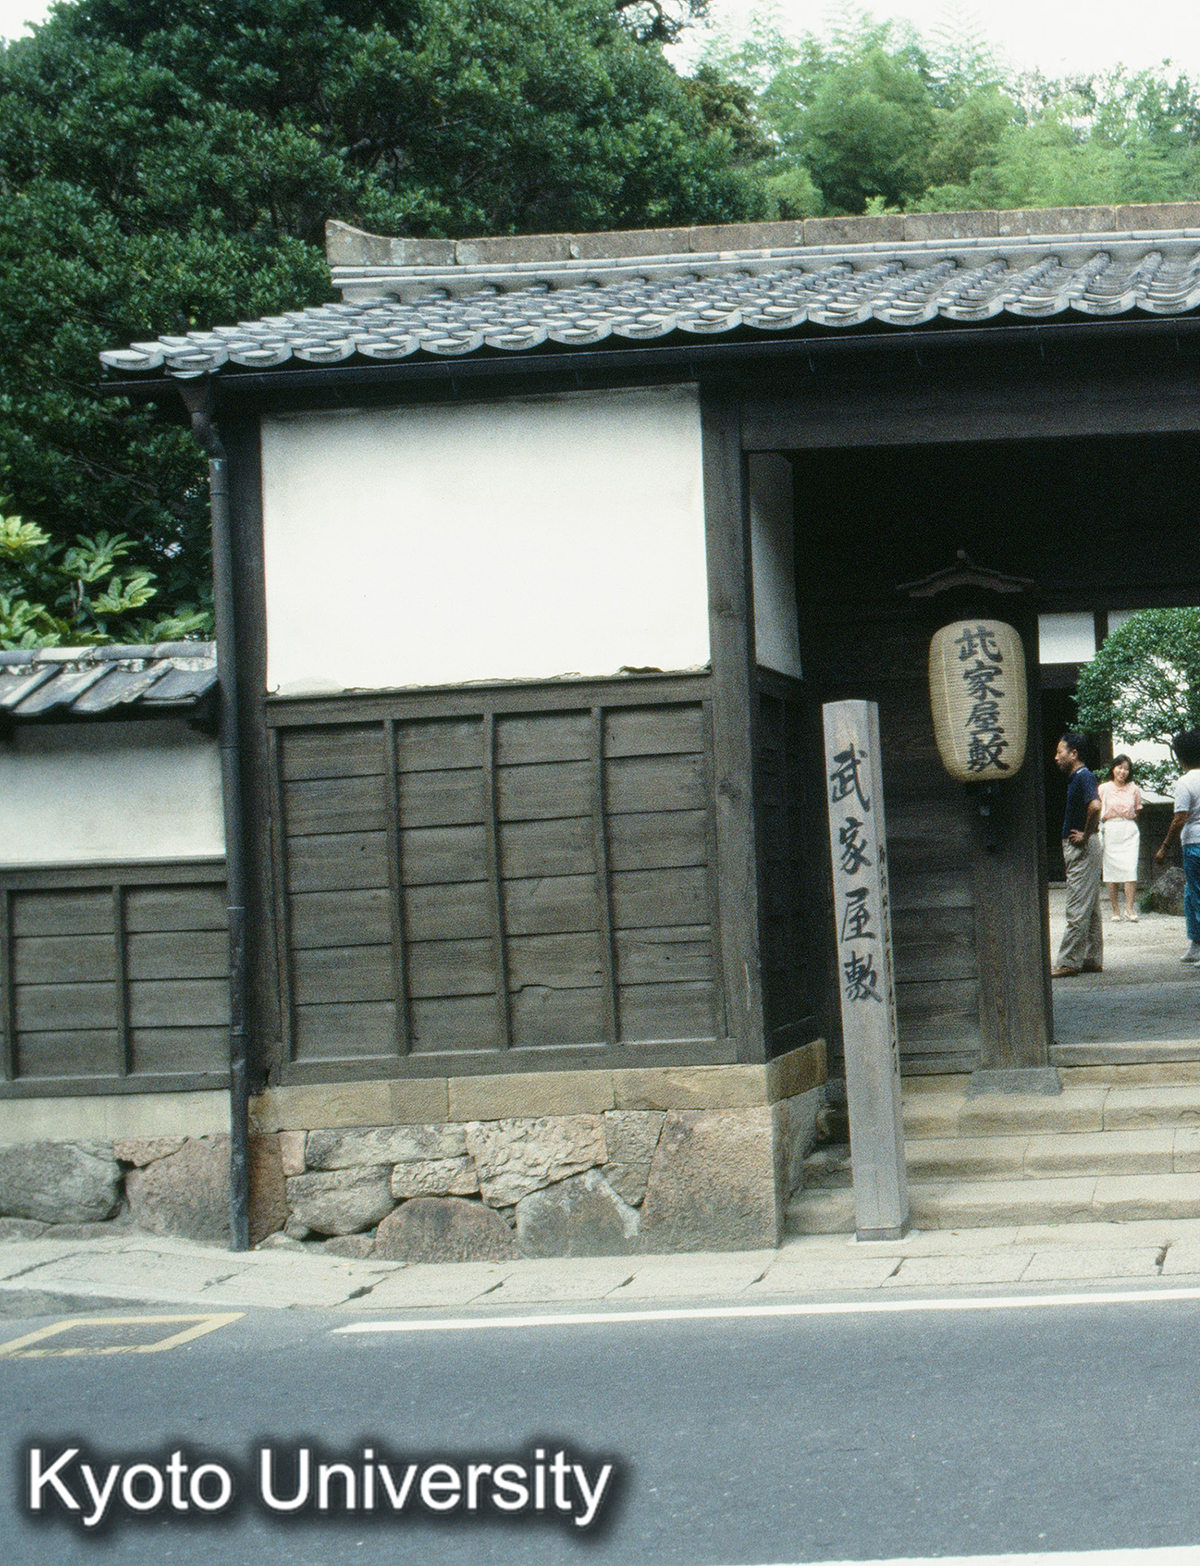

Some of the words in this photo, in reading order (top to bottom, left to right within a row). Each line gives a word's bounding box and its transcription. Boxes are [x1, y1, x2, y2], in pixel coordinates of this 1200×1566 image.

[954, 625, 1010, 772] 武家屋敷
[829, 743, 882, 1003] 武家屋敷
